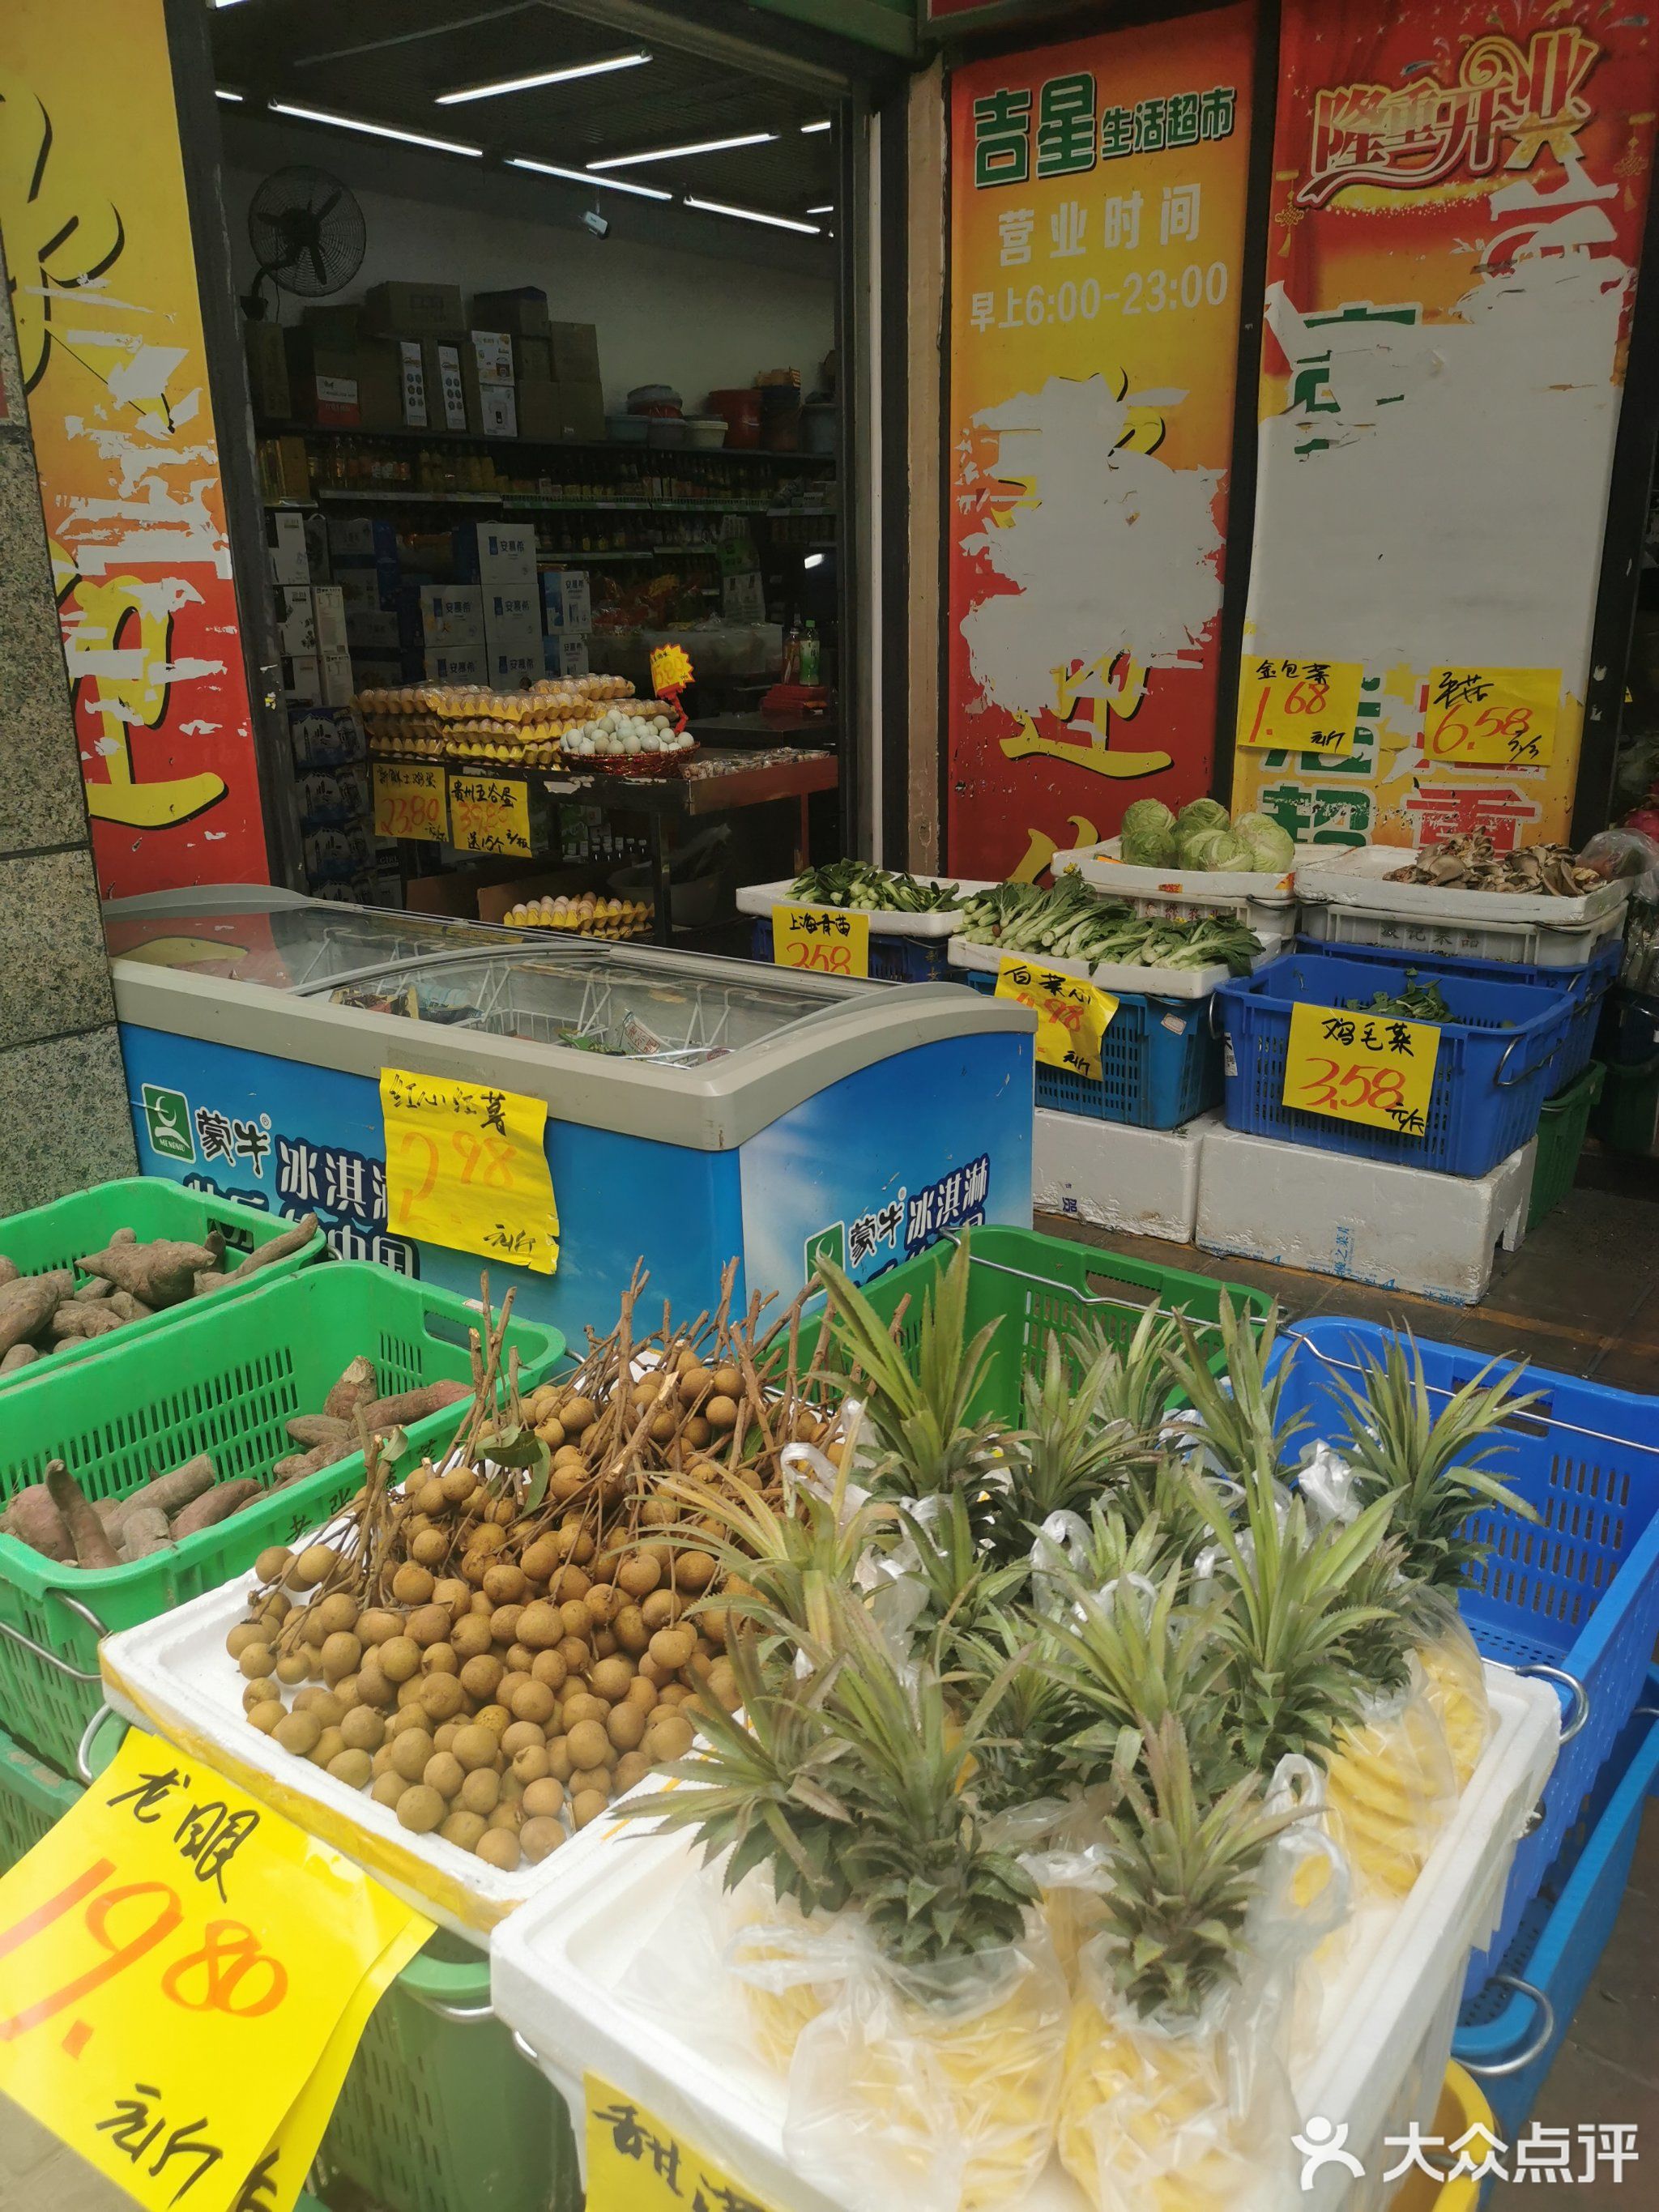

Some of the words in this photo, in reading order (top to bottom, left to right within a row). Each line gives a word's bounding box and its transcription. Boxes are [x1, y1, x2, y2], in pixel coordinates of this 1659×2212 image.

[974, 71, 1236, 189] 吉星生活超市
[999, 183, 1201, 266] 营业时间
[970, 262, 1228, 333] 早上6:00-23:00
[1248, 680, 1329, 743] 1.68
[1433, 702, 1534, 754] 6.58
[1321, 1017, 1414, 1057] 鸡毛菜
[1298, 1058, 1406, 1110] 3.58
[196, 1108, 270, 1178] 蒙牛
[851, 1204, 903, 1268] 蒙牛
[907, 1157, 987, 1243] 冰淇淋
[107, 1768, 259, 1903] 龙眼
